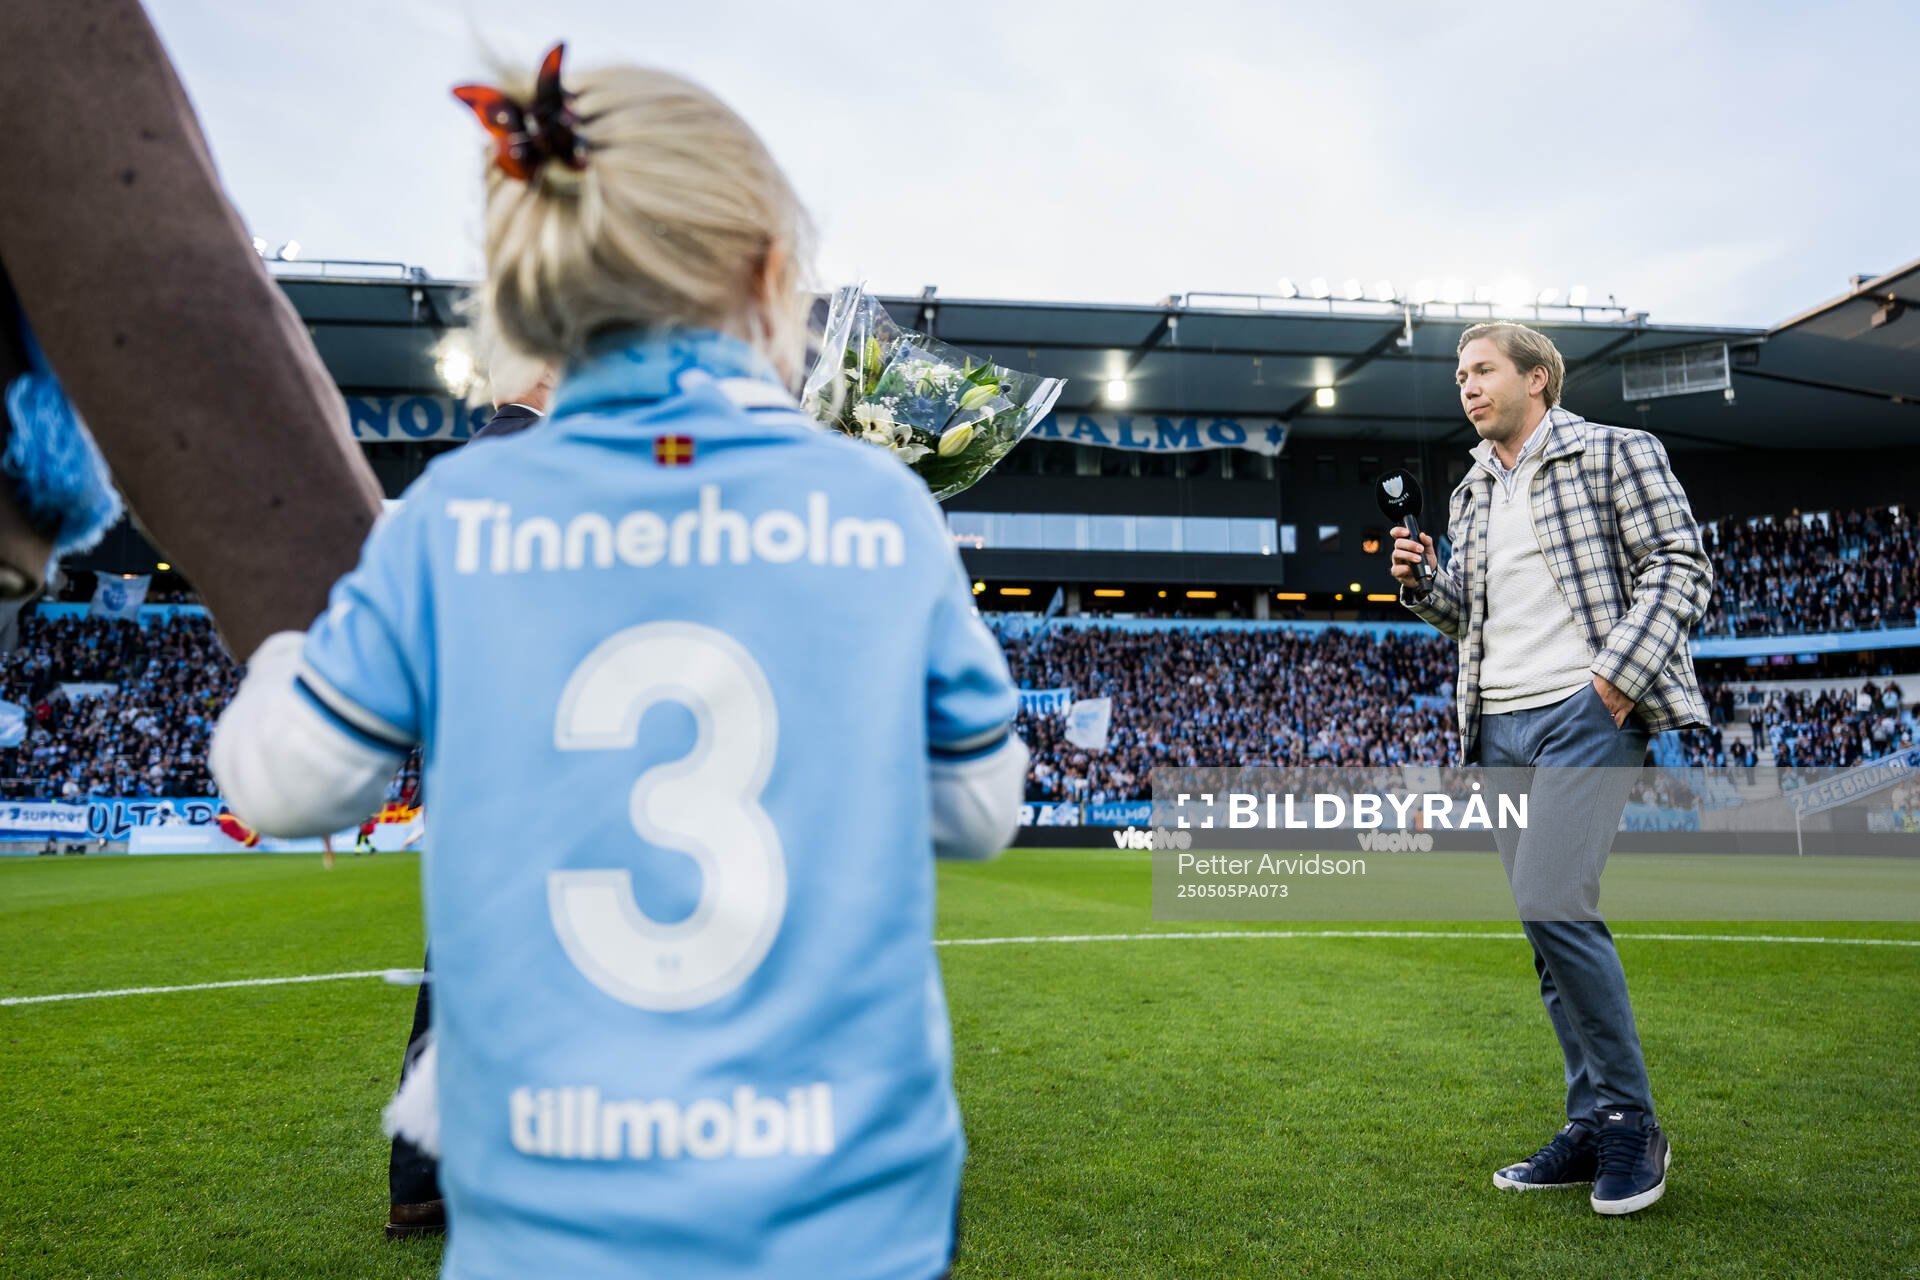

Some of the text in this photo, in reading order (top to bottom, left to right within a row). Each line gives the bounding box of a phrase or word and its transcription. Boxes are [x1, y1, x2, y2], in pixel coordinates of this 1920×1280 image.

[446, 484, 905, 574] Tinnerholm
[547, 620, 788, 1013] 3
[510, 1083, 835, 1161] tillmobil
